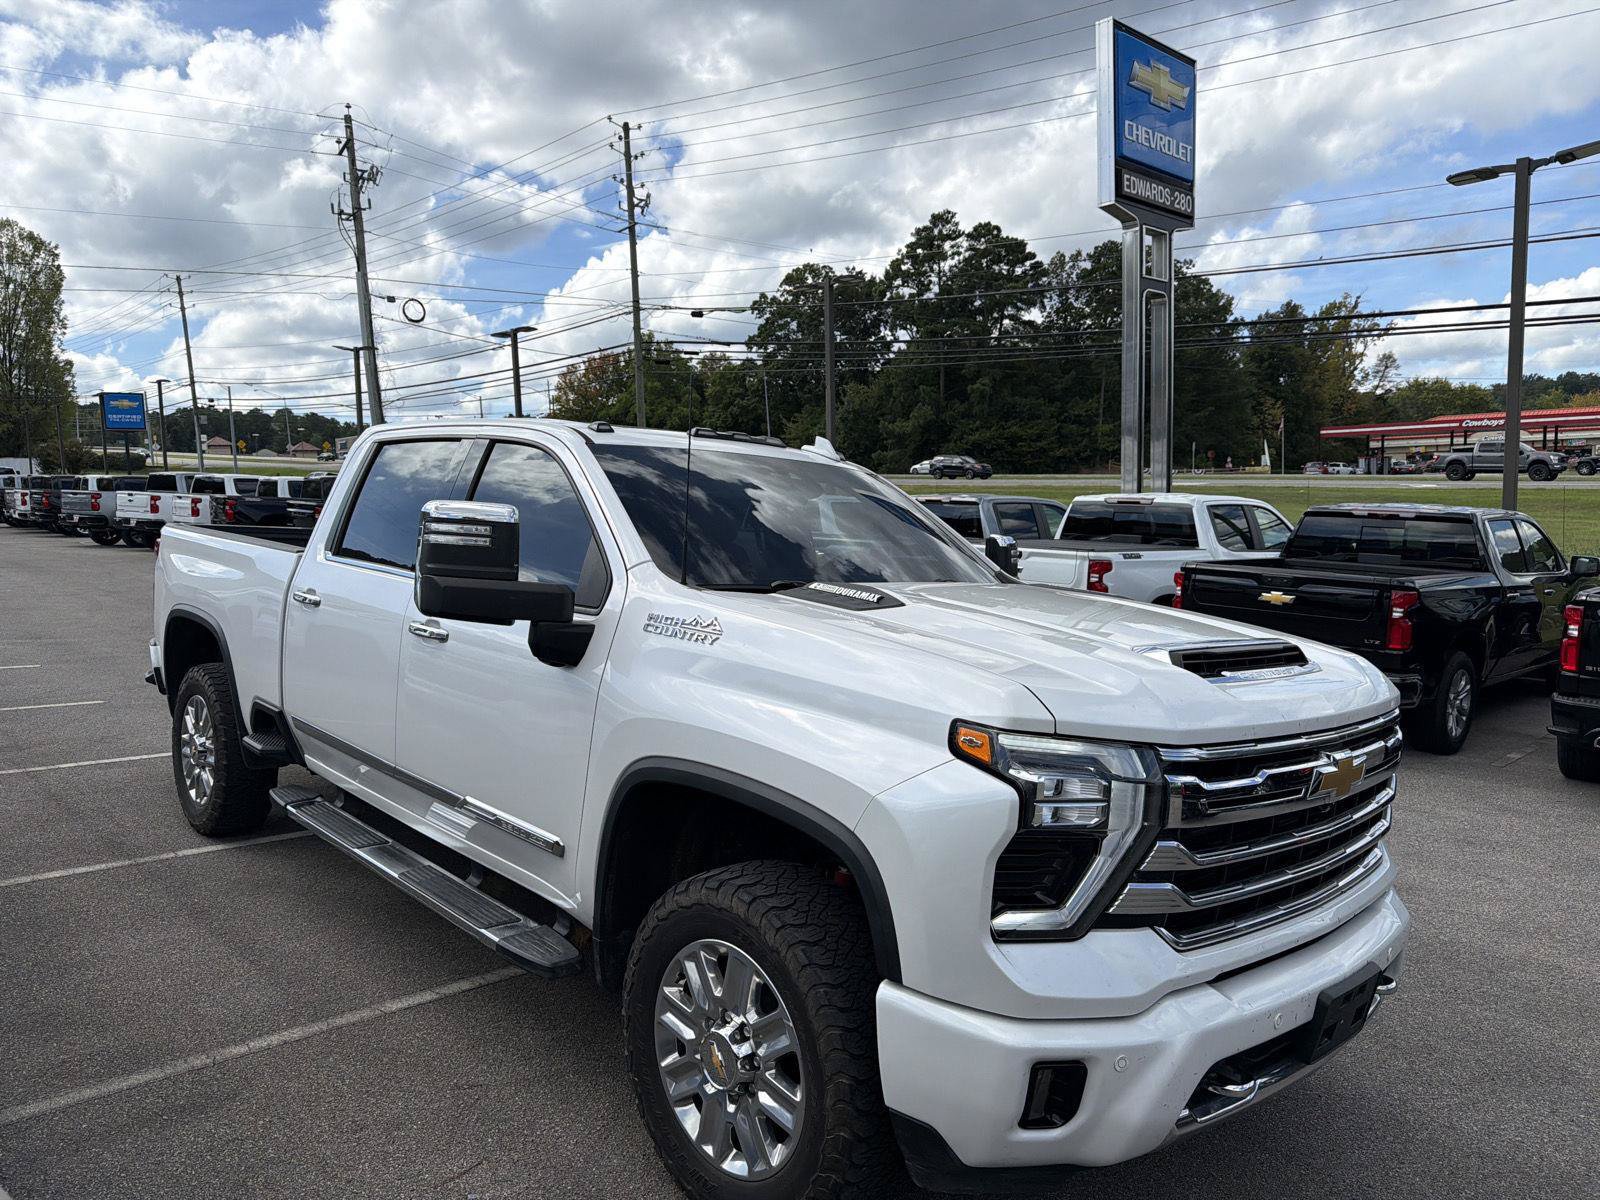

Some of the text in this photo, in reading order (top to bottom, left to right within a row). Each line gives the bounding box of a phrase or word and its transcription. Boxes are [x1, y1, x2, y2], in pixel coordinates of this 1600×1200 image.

[1124, 119, 1193, 163] CHEVROLET
[1123, 173, 1192, 213] EDWARDS-280
[1462, 419, 1505, 427] Cowboys
[836, 586, 882, 603] DURAMAX
[646, 612, 687, 627] HIGH
[642, 623, 720, 646] COUNTRY
